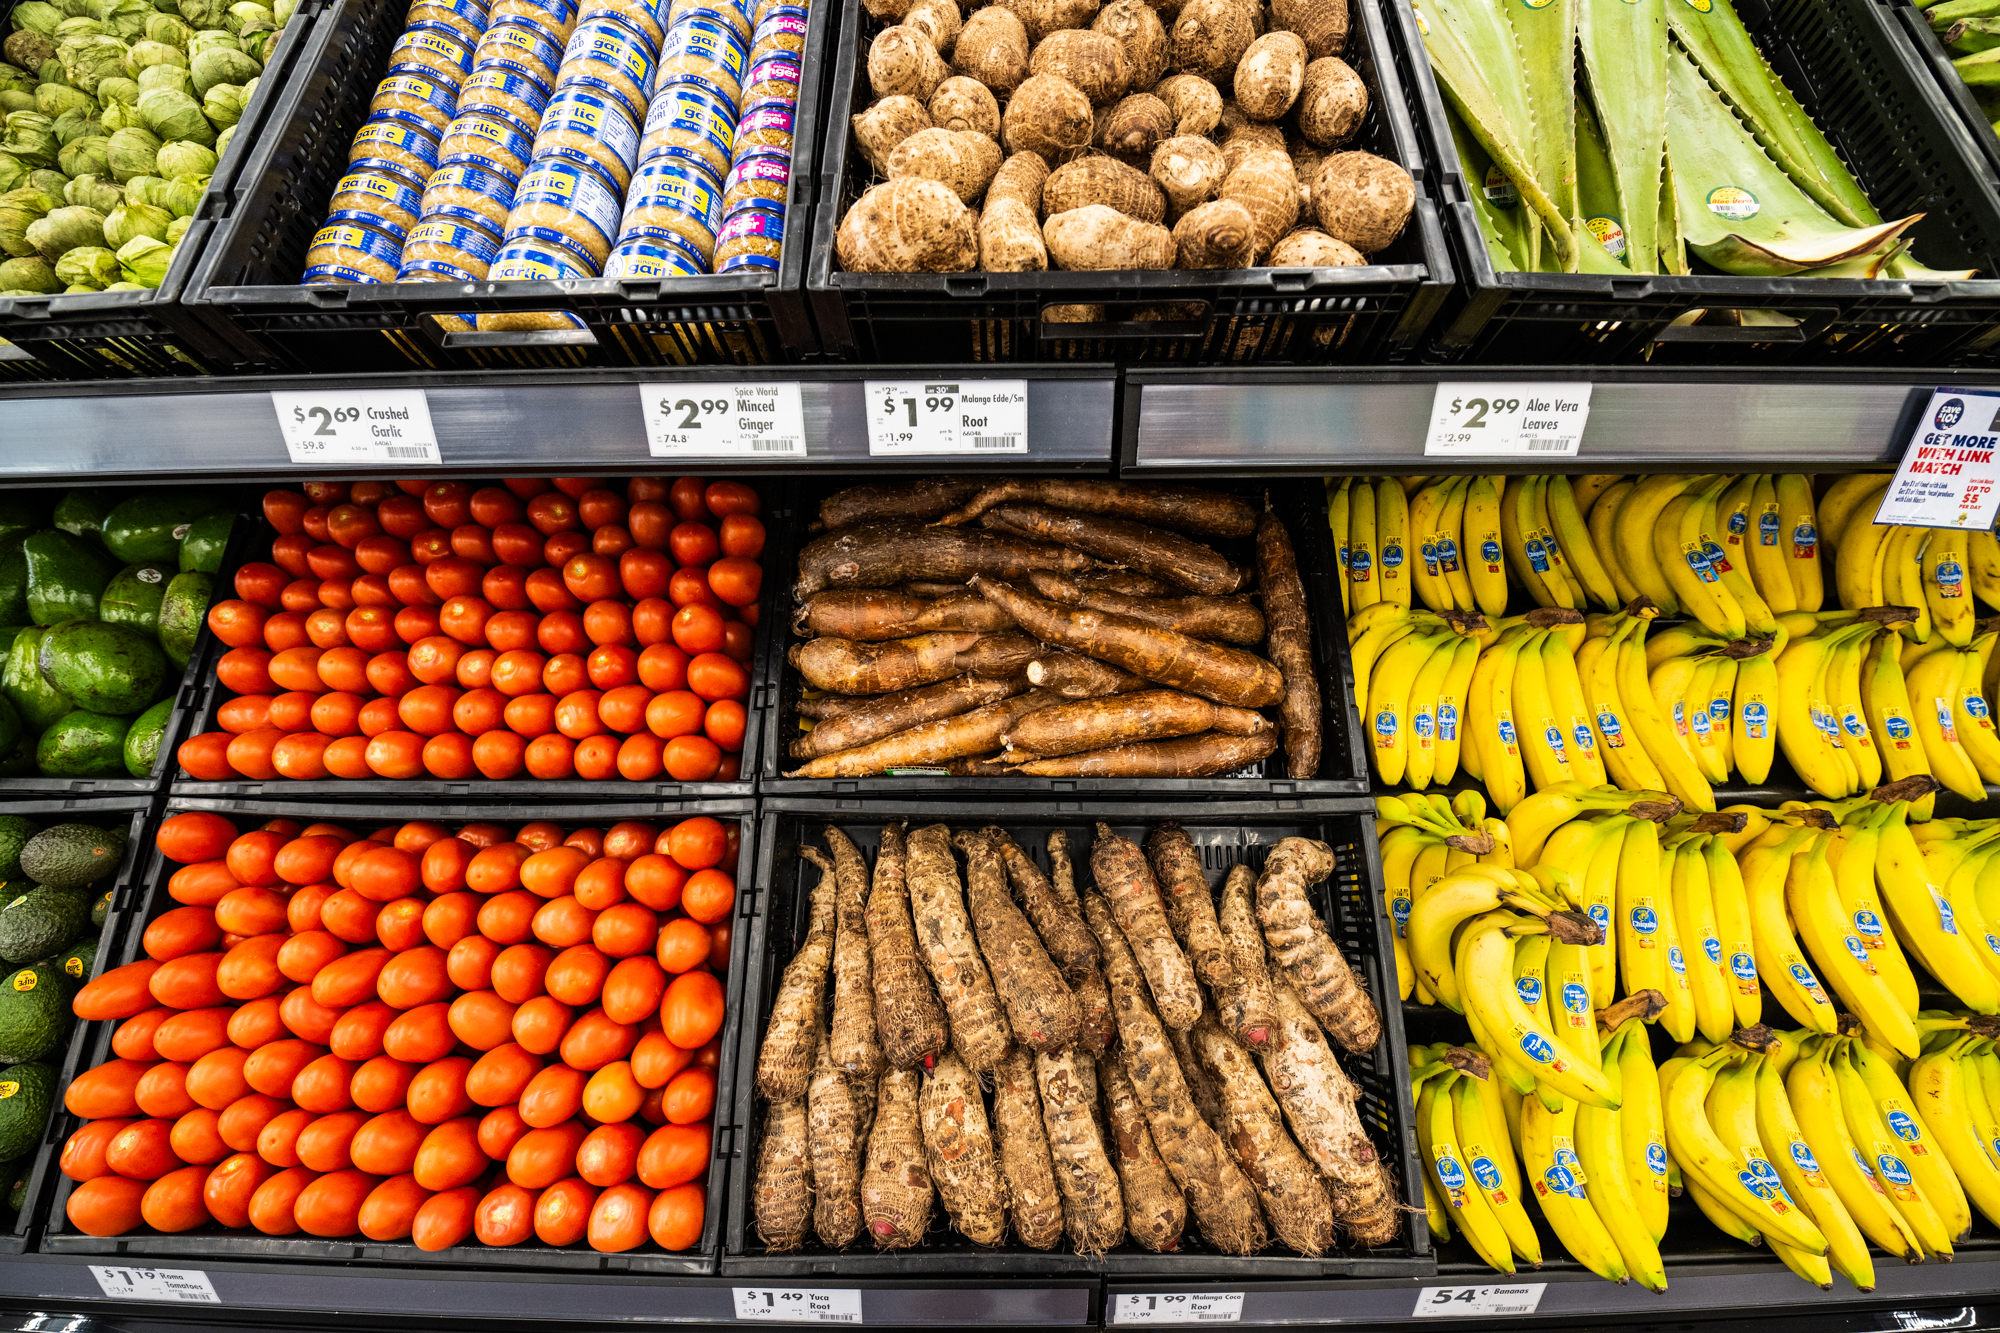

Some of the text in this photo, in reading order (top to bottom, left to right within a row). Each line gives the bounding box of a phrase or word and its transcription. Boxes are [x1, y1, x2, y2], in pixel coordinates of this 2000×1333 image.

[777, 19, 806, 33] ging
[486, 31, 528, 45] garlic
[410, 36, 455, 56] garlic
[691, 35, 737, 64] garlic
[593, 38, 641, 71] garlic
[755, 67, 799, 80] gnger
[381, 80, 423, 93] garlic
[548, 106, 596, 122] garlic
[454, 123, 500, 138] garlic
[684, 107, 730, 142] garlic
[743, 116, 787, 132] giger
[342, 179, 388, 194] garlic
[518, 176, 566, 195] garlic
[650, 182, 703, 205] garlic
[1602, 229, 1622, 243] Vera
[628, 263, 673, 277] garli
[734, 387, 779, 399] Spice World
[961, 393, 1024, 405] Malanga Edde/Sm
[737, 398, 775, 412] Minced
[1526, 398, 1579, 412] Aloe Vera
[1940, 405, 1962, 414] save
[367, 406, 409, 420] Crushed
[739, 417, 774, 433] Ginger
[962, 415, 988, 427] Root
[1522, 417, 1559, 430] Leaves
[371, 424, 403, 438] Garlic
[1444, 433, 1471, 443] $2.99
[1924, 433, 1998, 449] GET MORE
[1917, 447, 1995, 463] WITH LINK
[1909, 461, 1963, 475] MATCH
[1937, 490, 1955, 498] produce
[1966, 485, 1979, 493] UP
[1962, 493, 1980, 504] $5
[1632, 921, 1656, 930] Chiquita
[1857, 923, 1883, 932] Chiquita
[67, 964, 81, 973] RIPE
[17, 978, 35, 987] RIPE
[1516, 988, 1540, 1000] Chiquita
[1440, 1173, 1464, 1184] Chiquita
[1882, 1169, 1911, 1180] Chiquita
[159, 1272, 184, 1280] Roma
[164, 1281, 203, 1290] Tomatoes
[809, 1293, 829, 1301] Yuca
[1192, 1294, 1223, 1302] Malanga
[809, 1302, 830, 1310] Root
